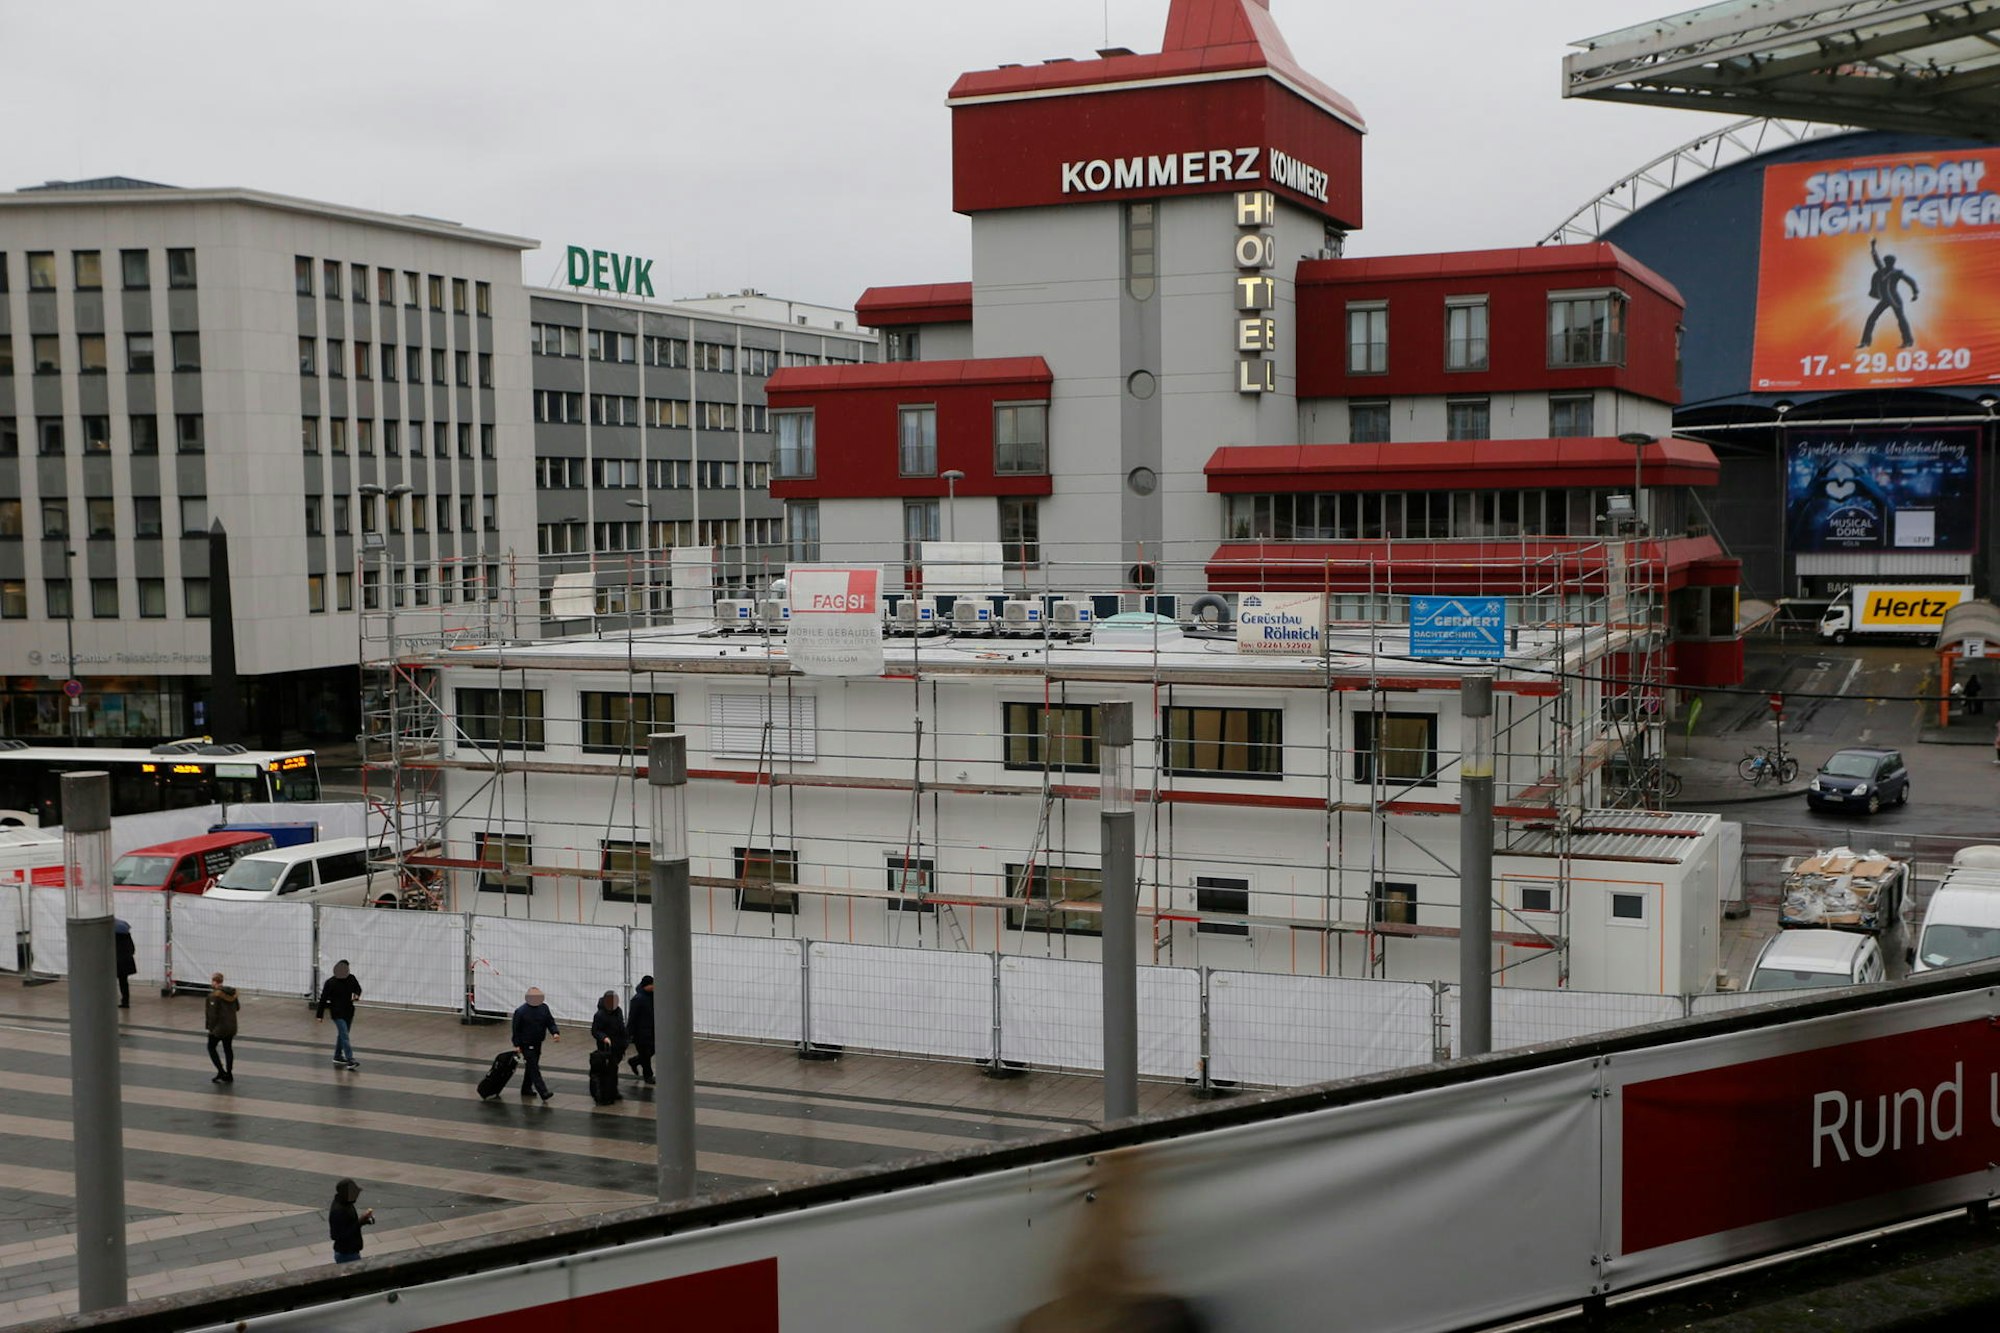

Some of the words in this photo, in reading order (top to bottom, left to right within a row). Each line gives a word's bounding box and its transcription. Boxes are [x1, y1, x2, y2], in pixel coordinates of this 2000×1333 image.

[1062, 146, 1260, 193] KOMMERZ
[1269, 147, 1328, 203] KOMMERZ
[1805, 160, 1985, 204] SATURDAY
[1784, 200, 1893, 239] NIGHT
[567, 245, 655, 298] DEVK
[1236, 193, 1263, 391] HOTEL
[1855, 348, 1971, 374] 29.03.20
[1829, 518, 1873, 529] MUSICAL
[1836, 529, 1866, 537] DOME
[812, 594, 865, 609] FAGSI
[1873, 598, 1947, 617] Hertz
[1414, 631, 1478, 639] DACHTECHNIK
[1969, 644, 1978, 656] F
[1812, 1060, 1964, 1169] Rund
